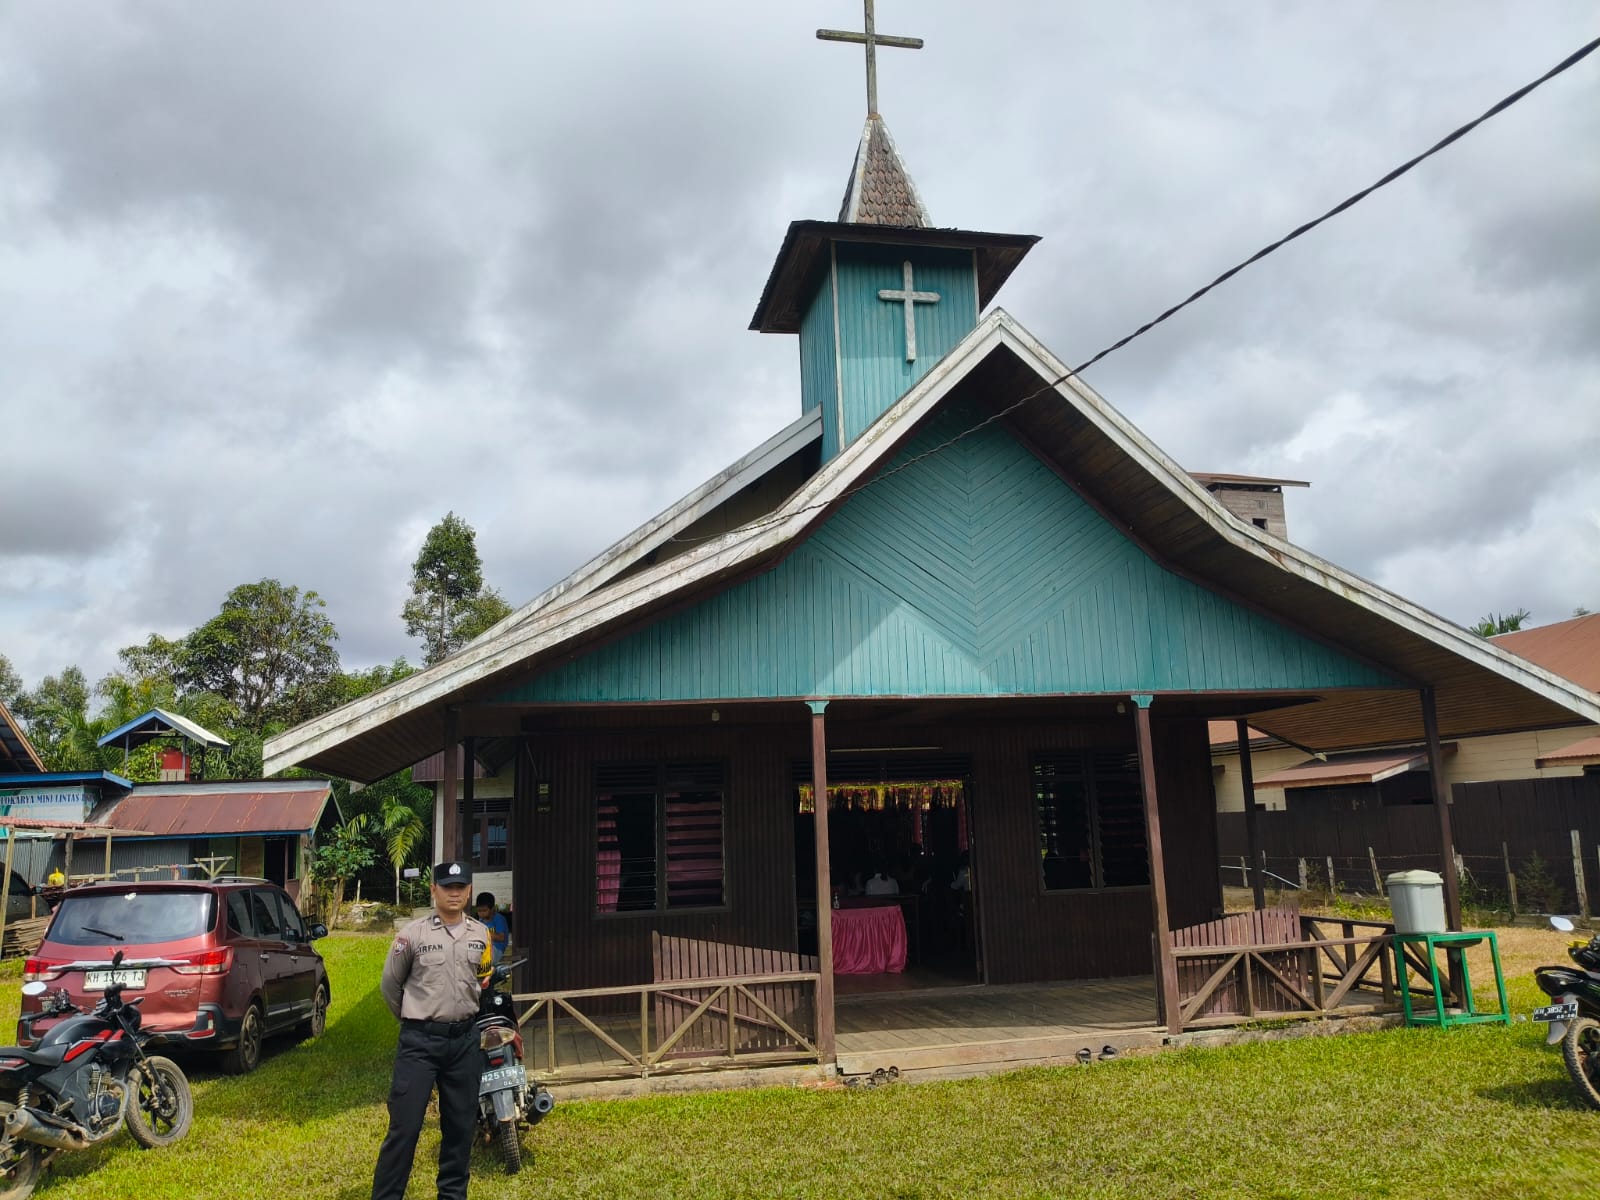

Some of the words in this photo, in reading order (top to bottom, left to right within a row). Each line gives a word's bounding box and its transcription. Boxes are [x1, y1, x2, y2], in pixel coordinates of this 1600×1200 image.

[56, 793, 80, 803] LINTAS
[419, 943, 443, 953] IRFAN
[87, 972, 99, 983] KH
[133, 970, 144, 981] TJ
